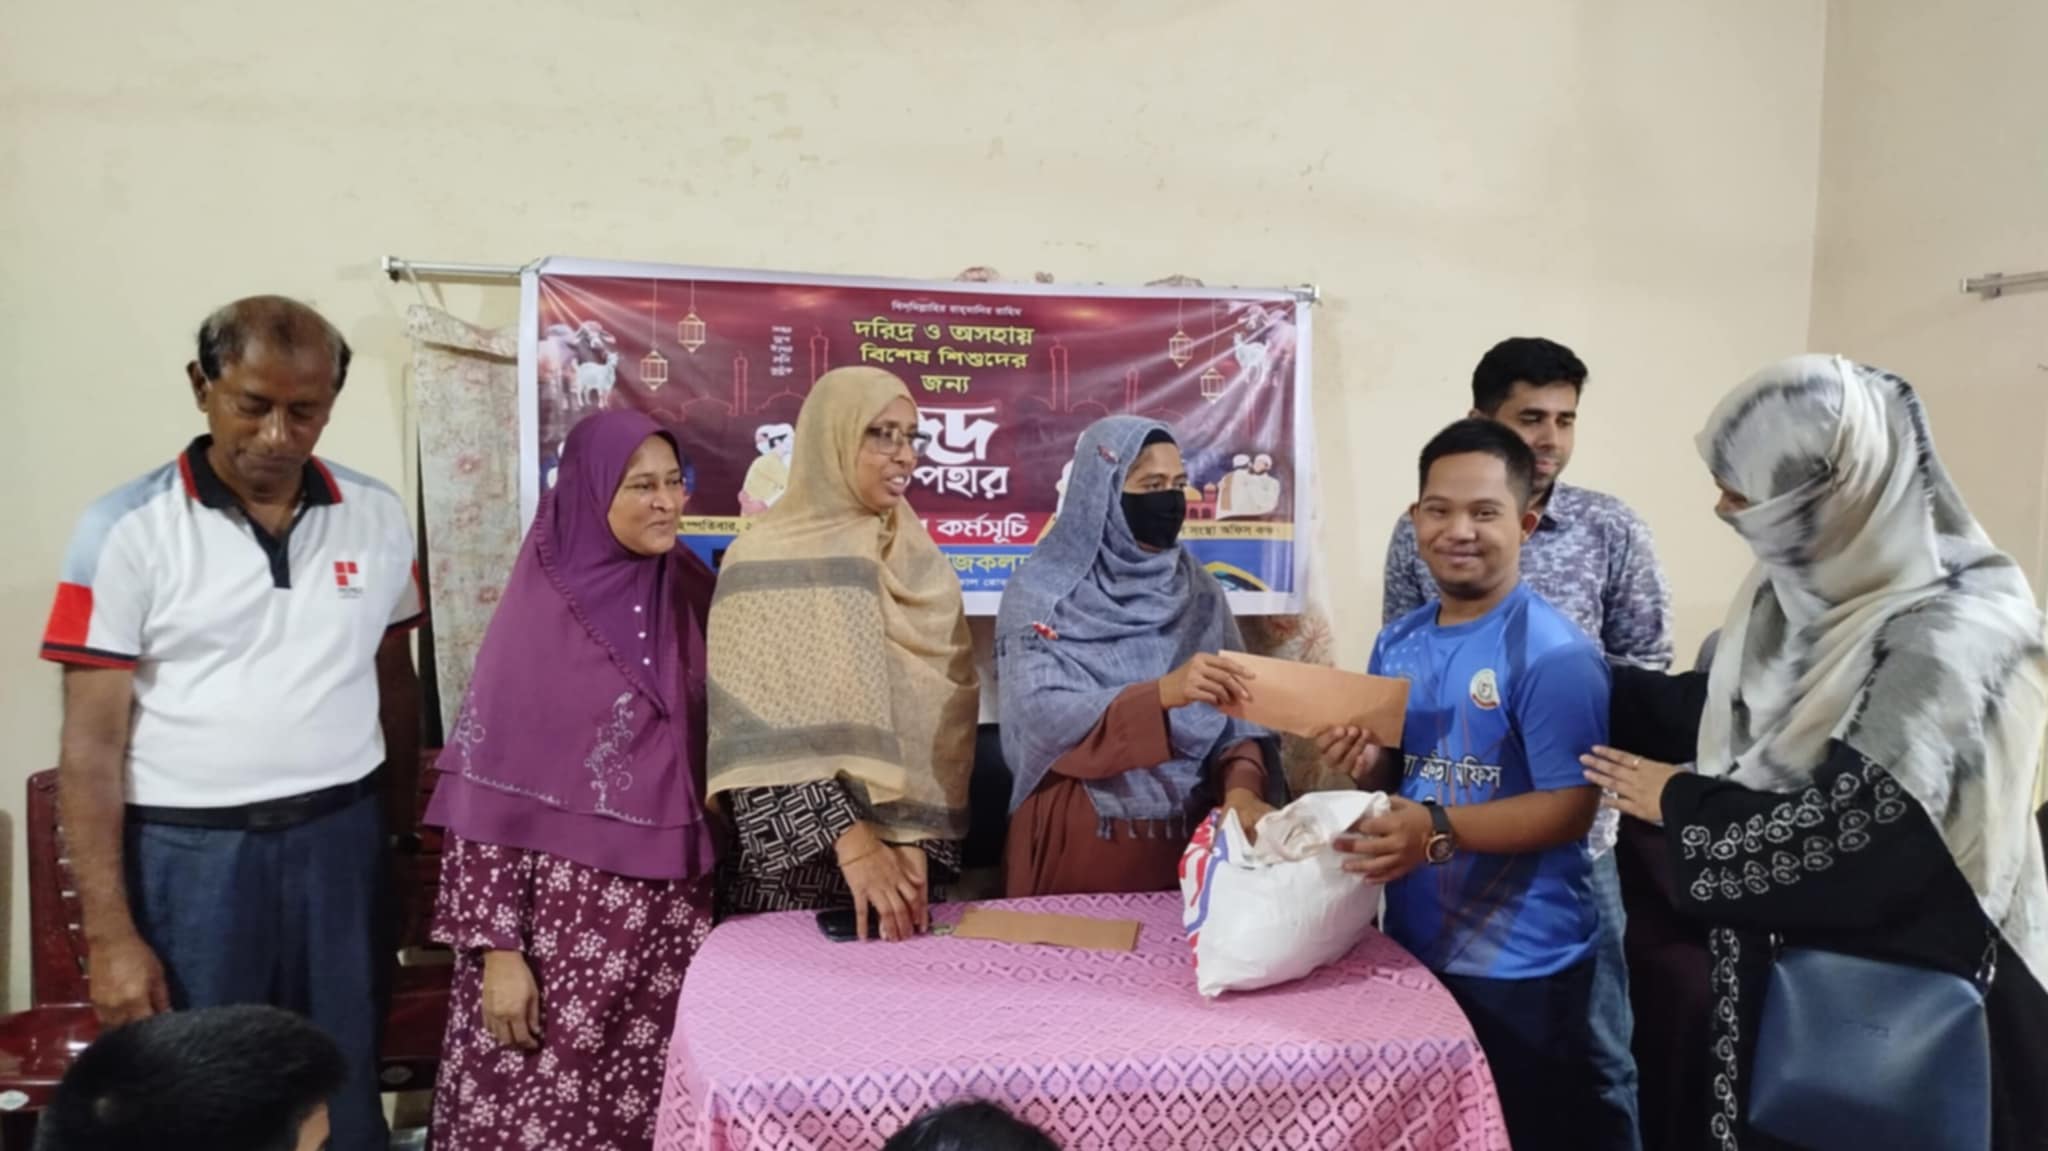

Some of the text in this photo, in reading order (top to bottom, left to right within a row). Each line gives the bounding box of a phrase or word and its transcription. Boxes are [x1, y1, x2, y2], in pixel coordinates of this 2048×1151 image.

[853, 316, 1035, 345] দরিদ্র ও অসহায়
[860, 342, 1029, 369] বিশেষ শিশুদের
[920, 373, 972, 393] জন্য
[912, 465, 1011, 500] পহার
[936, 513, 1031, 544] কর্মসূচি
